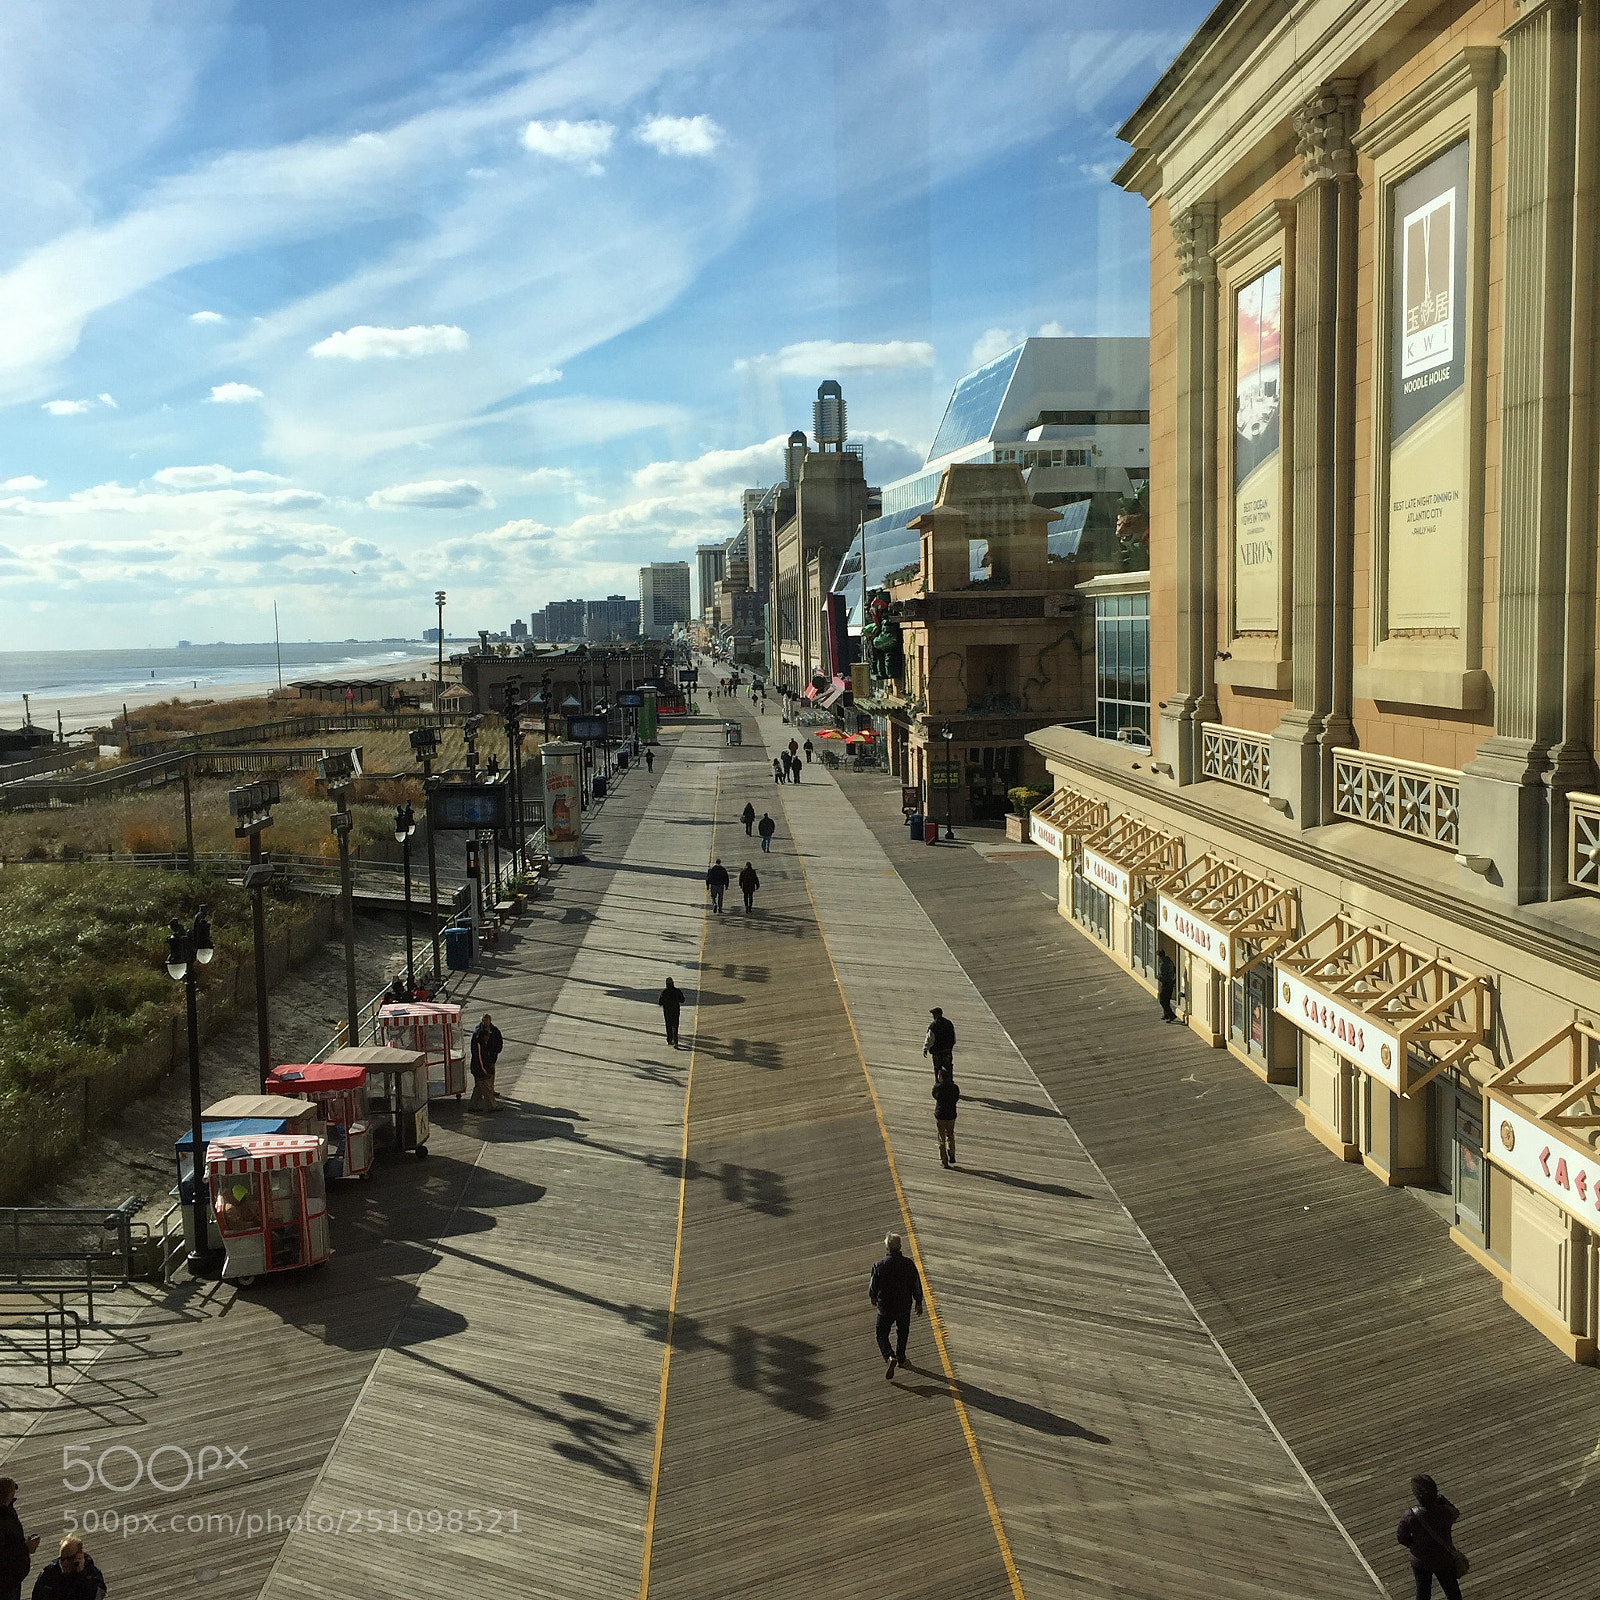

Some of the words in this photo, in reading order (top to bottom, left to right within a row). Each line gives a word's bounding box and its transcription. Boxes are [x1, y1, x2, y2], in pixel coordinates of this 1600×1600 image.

[1403, 374, 1428, 394] NOODLE
[1428, 366, 1450, 385] HOUSE
[1393, 500, 1404, 511] BEST
[1405, 498, 1416, 509] LATE
[1417, 494, 1432, 507] NIGHT
[1433, 491, 1452, 503] DINING
[1452, 490, 1459, 500] IN
[1407, 509, 1430, 523] ATLANTIC
[1430, 507, 1443, 519] CITY
[1240, 540, 1273, 566] NERO'S
[1093, 861, 1118, 889] CAESARS
[1175, 913, 1211, 951] CAESARS
[1303, 994, 1365, 1052] CAESARS
